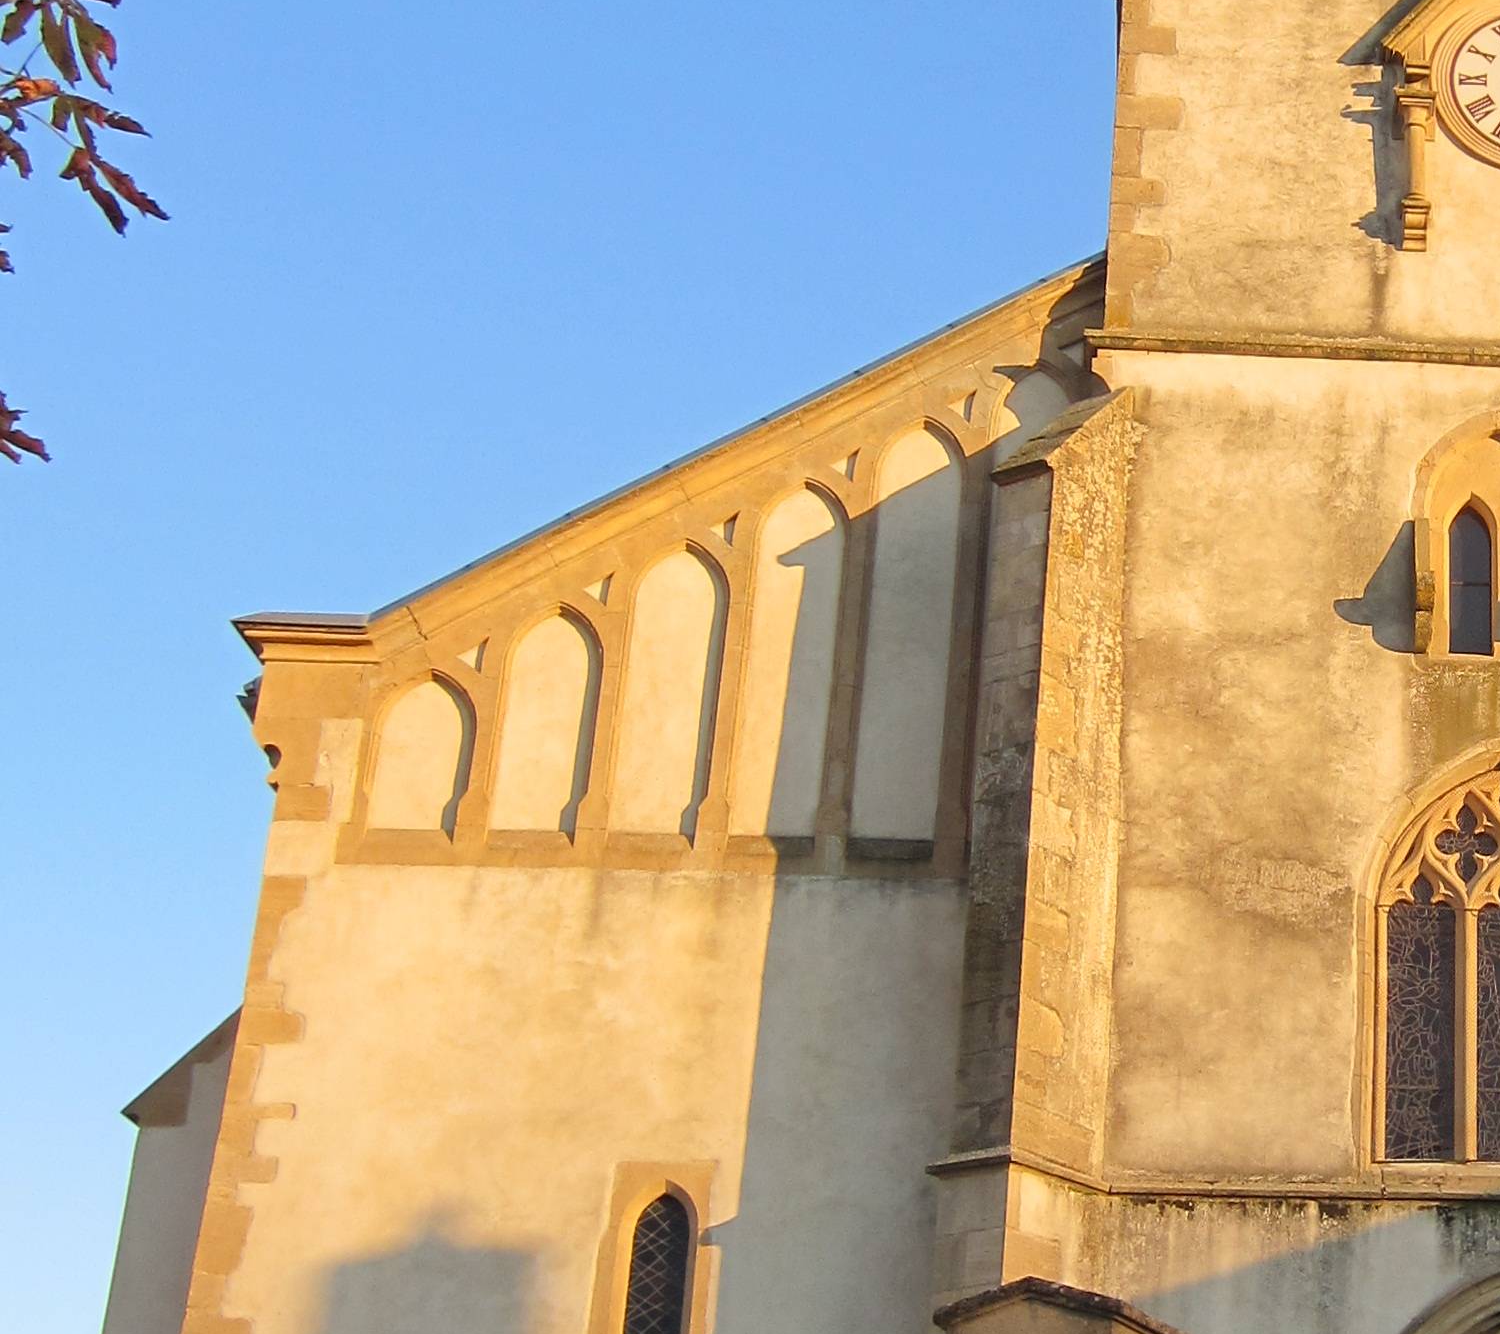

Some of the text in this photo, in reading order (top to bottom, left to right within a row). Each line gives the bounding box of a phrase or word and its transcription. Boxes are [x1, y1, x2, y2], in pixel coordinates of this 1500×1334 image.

[1467, 45, 1496, 63] X
[1458, 73, 1488, 87] IX
[1465, 95, 1496, 123] VIII
